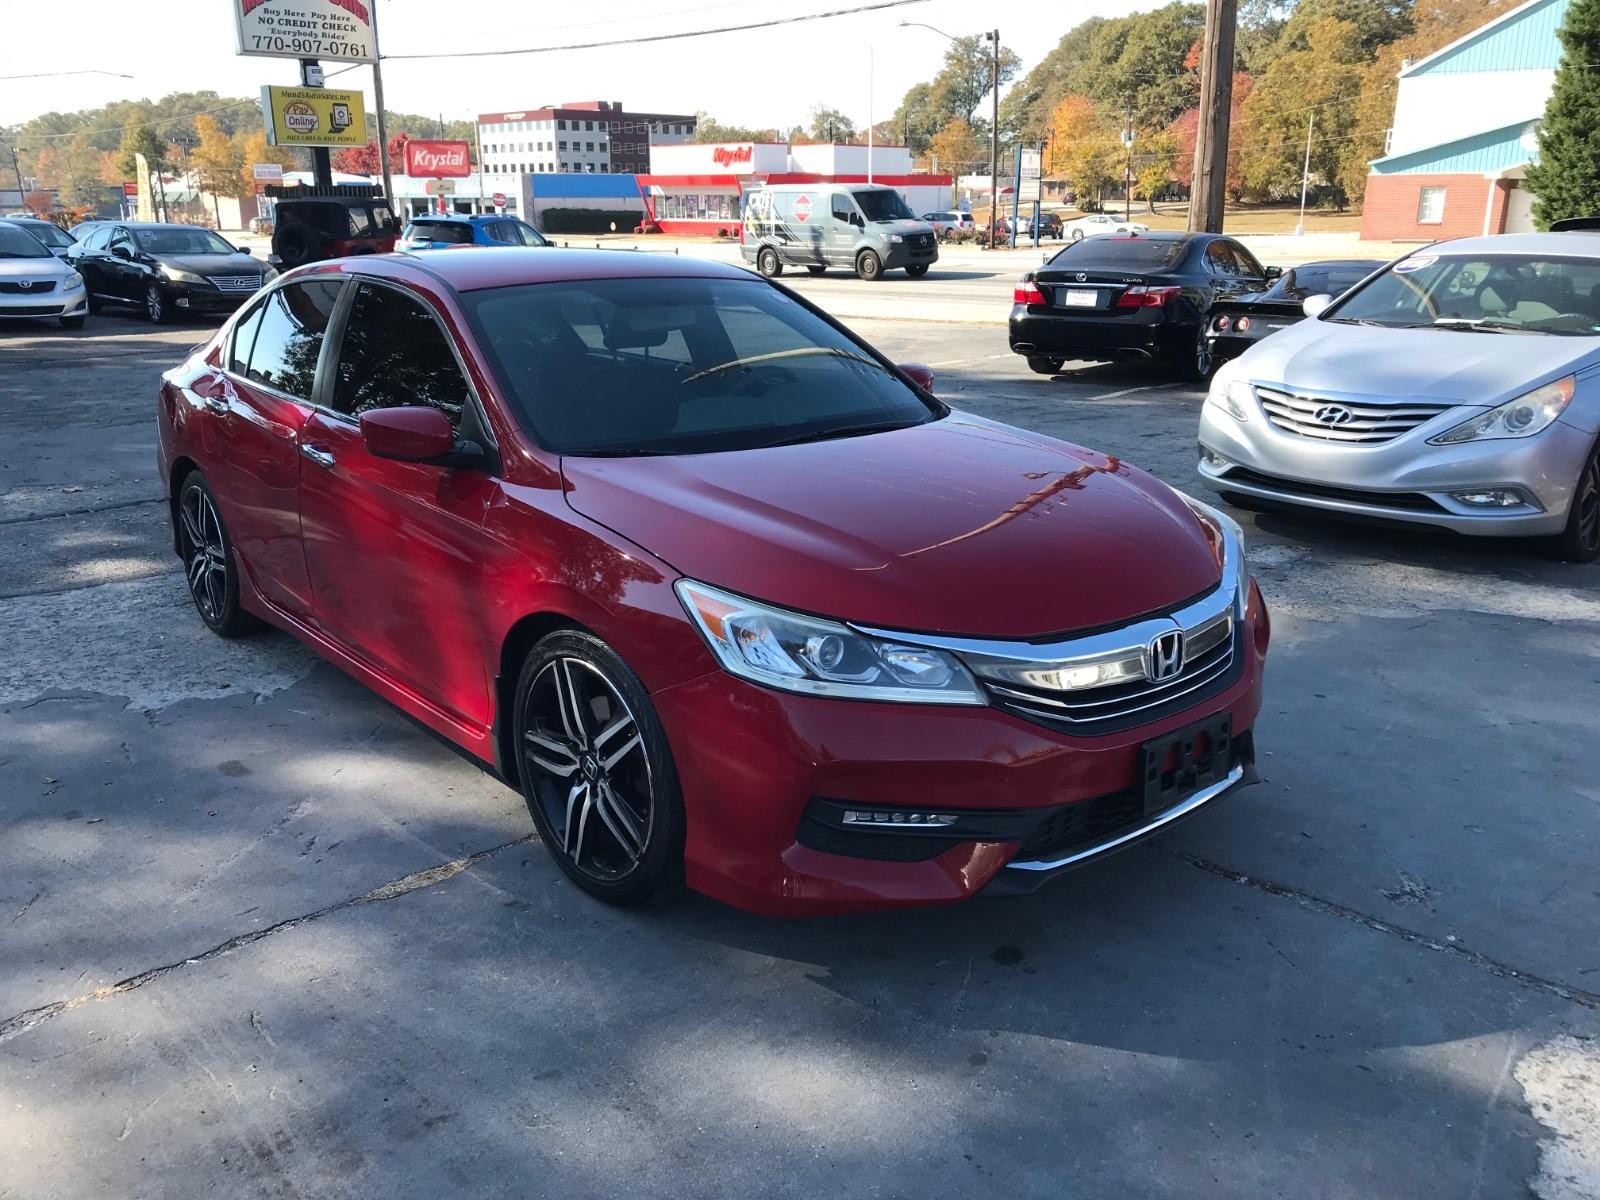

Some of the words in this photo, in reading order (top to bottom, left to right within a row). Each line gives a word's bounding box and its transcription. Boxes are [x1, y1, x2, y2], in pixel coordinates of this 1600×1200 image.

[263, 8, 280, 17] Buy
[284, 9, 306, 18] Here
[311, 12, 327, 20] Pay
[330, 13, 350, 22] Here
[258, 17, 274, 25] NO
[278, 18, 318, 29] CREDIT
[322, 22, 357, 32] CHECK
[252, 35, 368, 57] 770-907-0761
[293, 104, 309, 115] Pay
[288, 115, 315, 126] Online
[413, 150, 464, 171] Krystal
